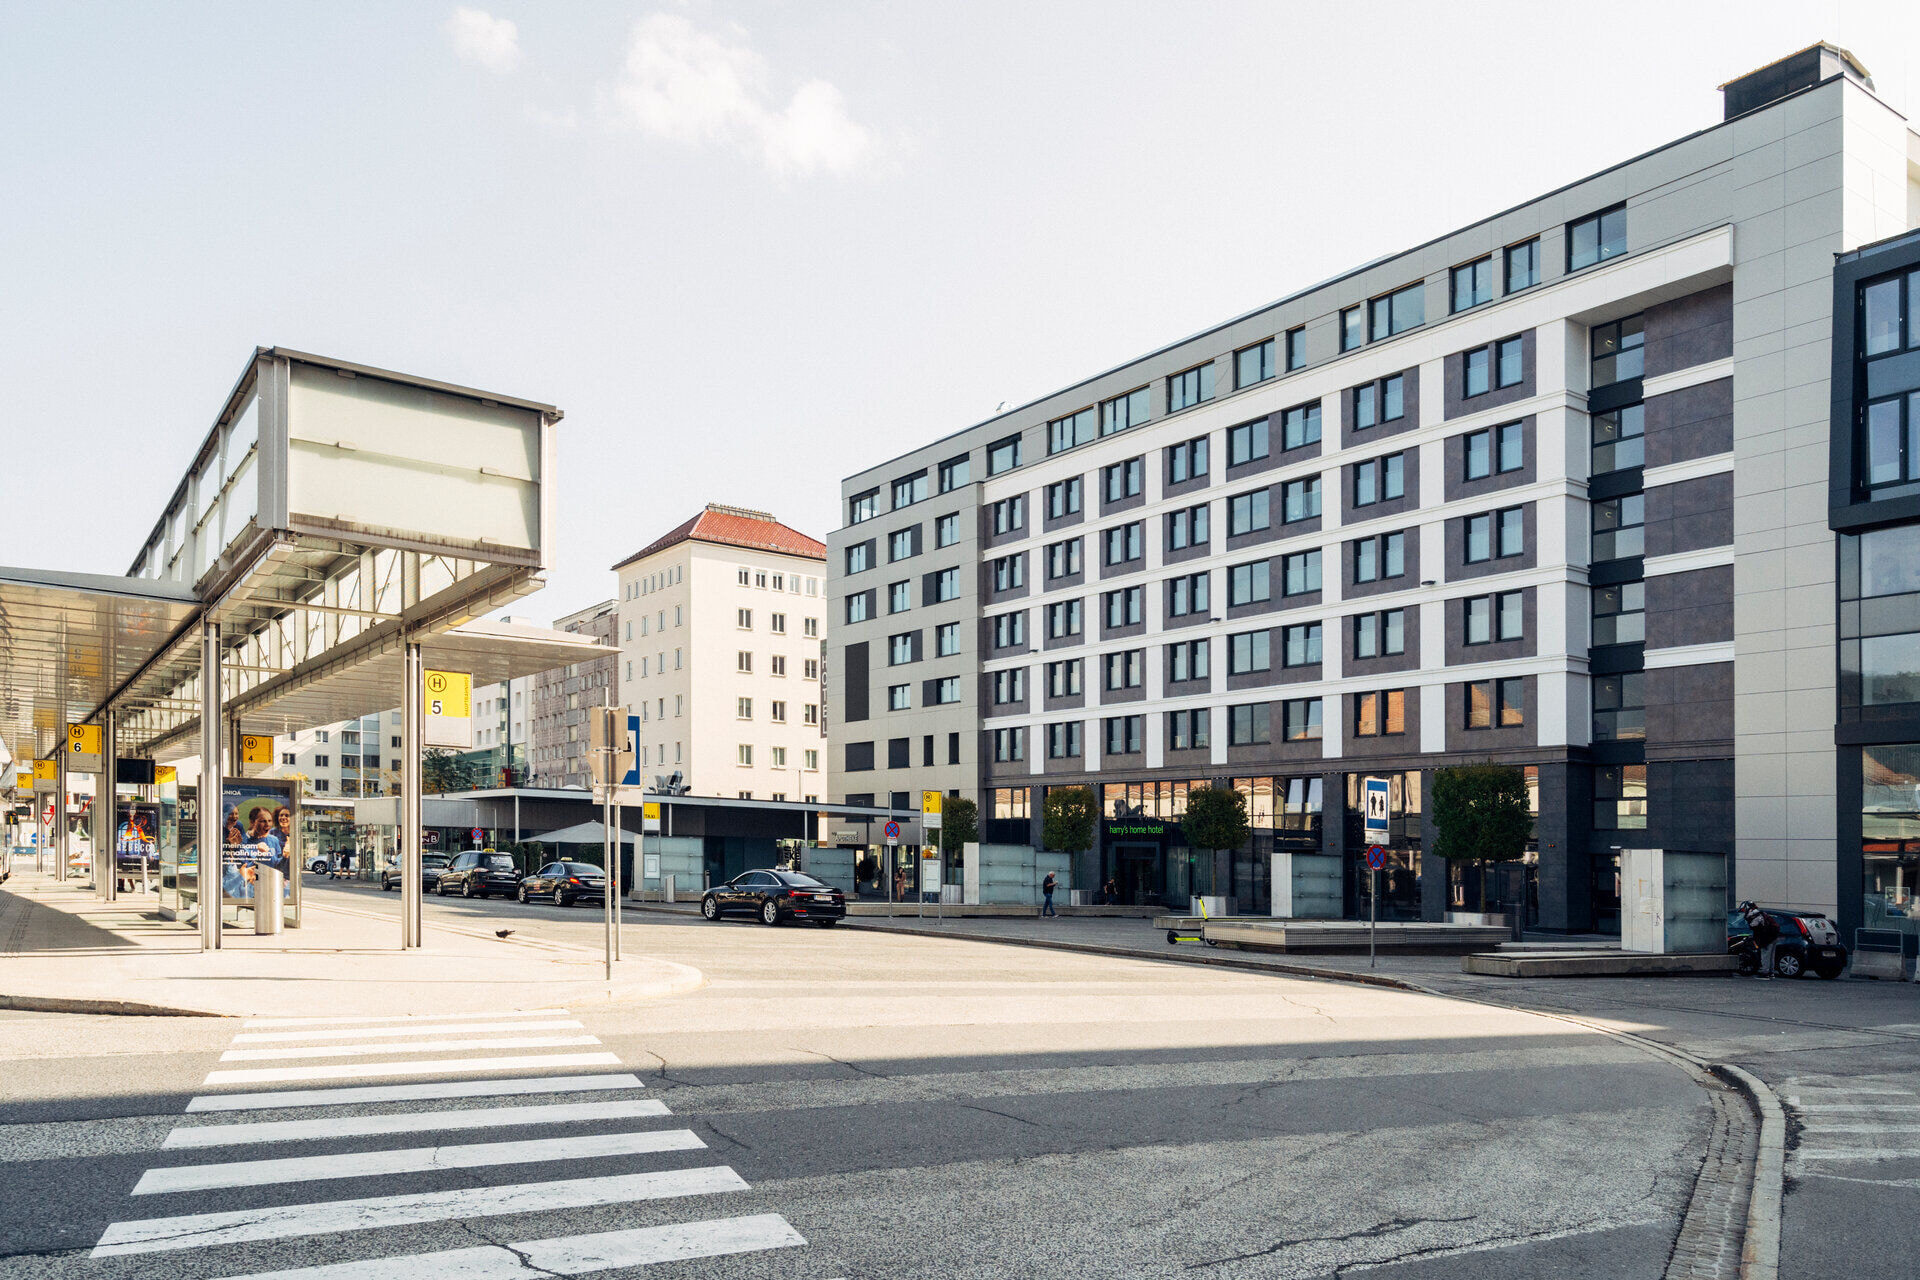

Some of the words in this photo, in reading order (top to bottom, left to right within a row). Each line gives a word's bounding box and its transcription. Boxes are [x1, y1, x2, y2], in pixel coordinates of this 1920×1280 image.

[432, 700, 442, 714] 5
[74, 742, 81, 752] 6
[1109, 825, 1129, 836] harry's
[1130, 825, 1147, 834] home
[1148, 825, 1164, 834] hotel
